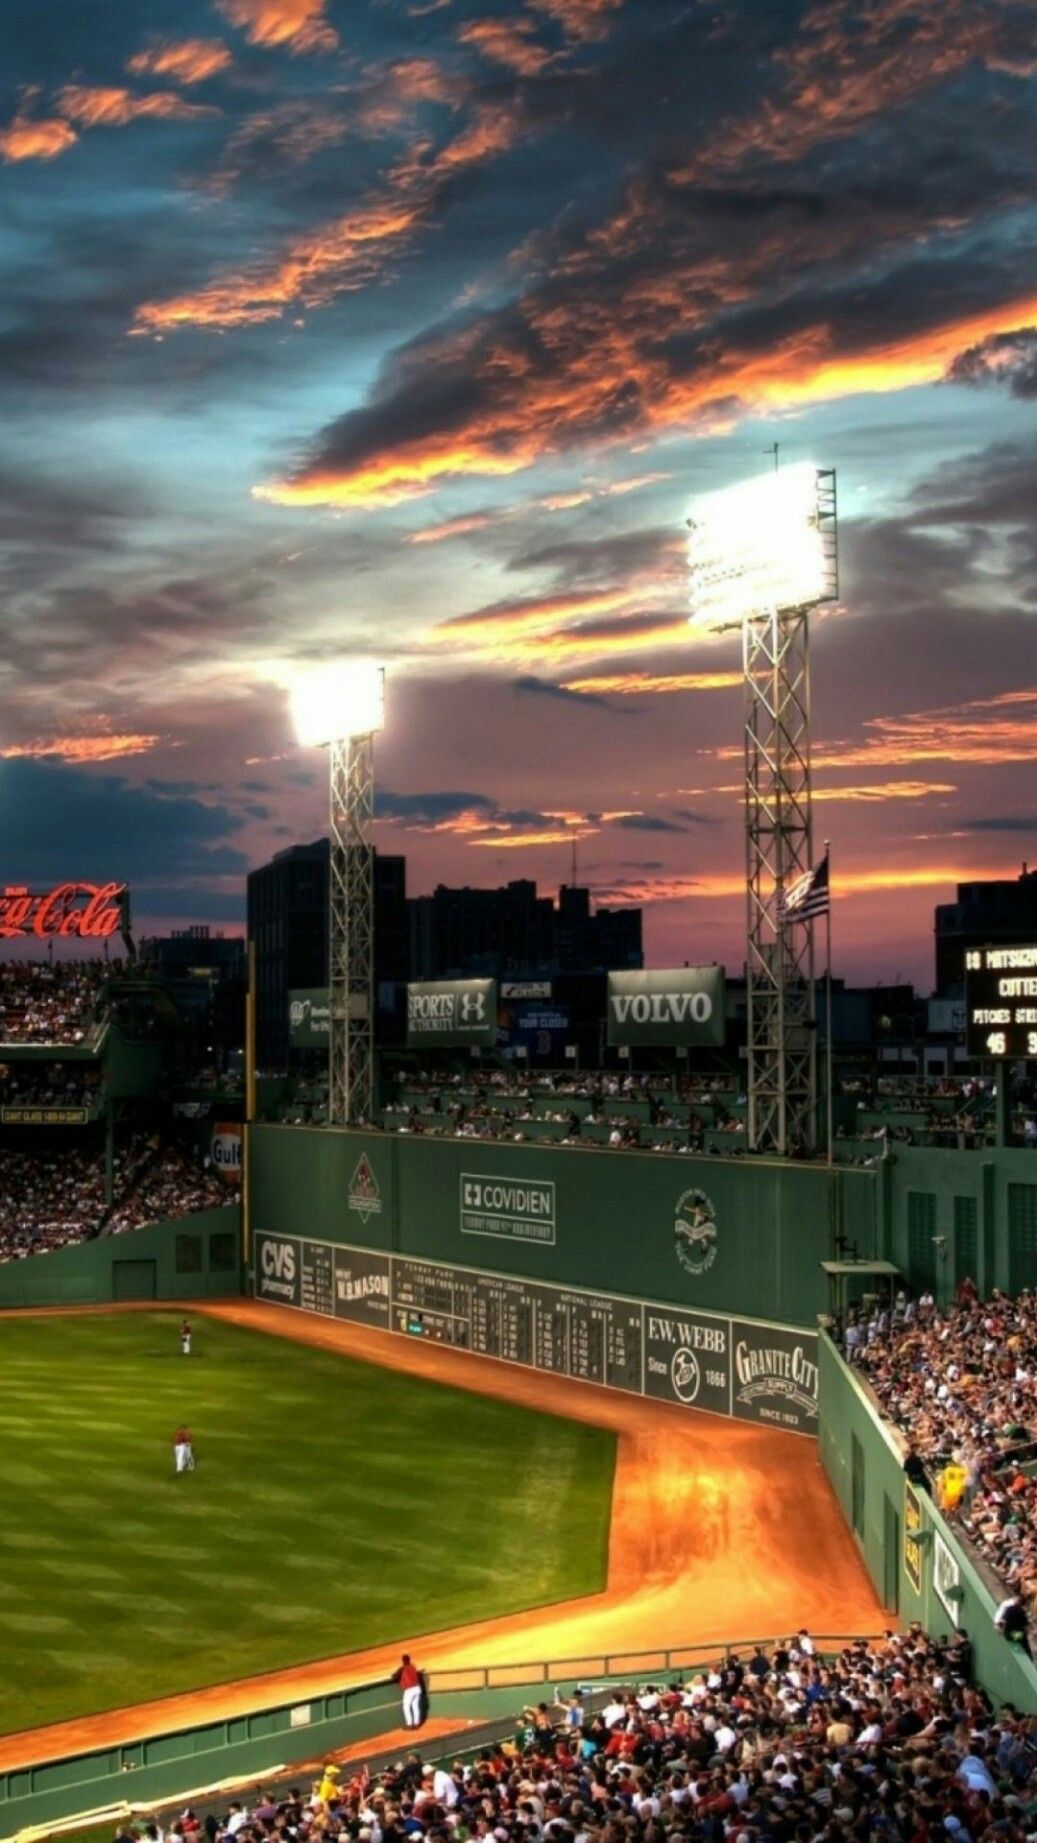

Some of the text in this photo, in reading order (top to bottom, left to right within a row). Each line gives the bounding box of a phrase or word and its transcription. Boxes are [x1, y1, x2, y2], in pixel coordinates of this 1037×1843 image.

[408, 993, 454, 1018] SPORTS
[611, 992, 713, 1023] VOLVO
[973, 1009, 1011, 1024] PITCHES
[484, 1186, 550, 1215] COVIDIEN
[262, 1241, 296, 1280] CVS
[262, 1277, 296, 1300] pharmacy
[677, 1323, 726, 1353] WEBB
[648, 1357, 668, 1375] Since
[735, 1340, 791, 1385] GRANITE
